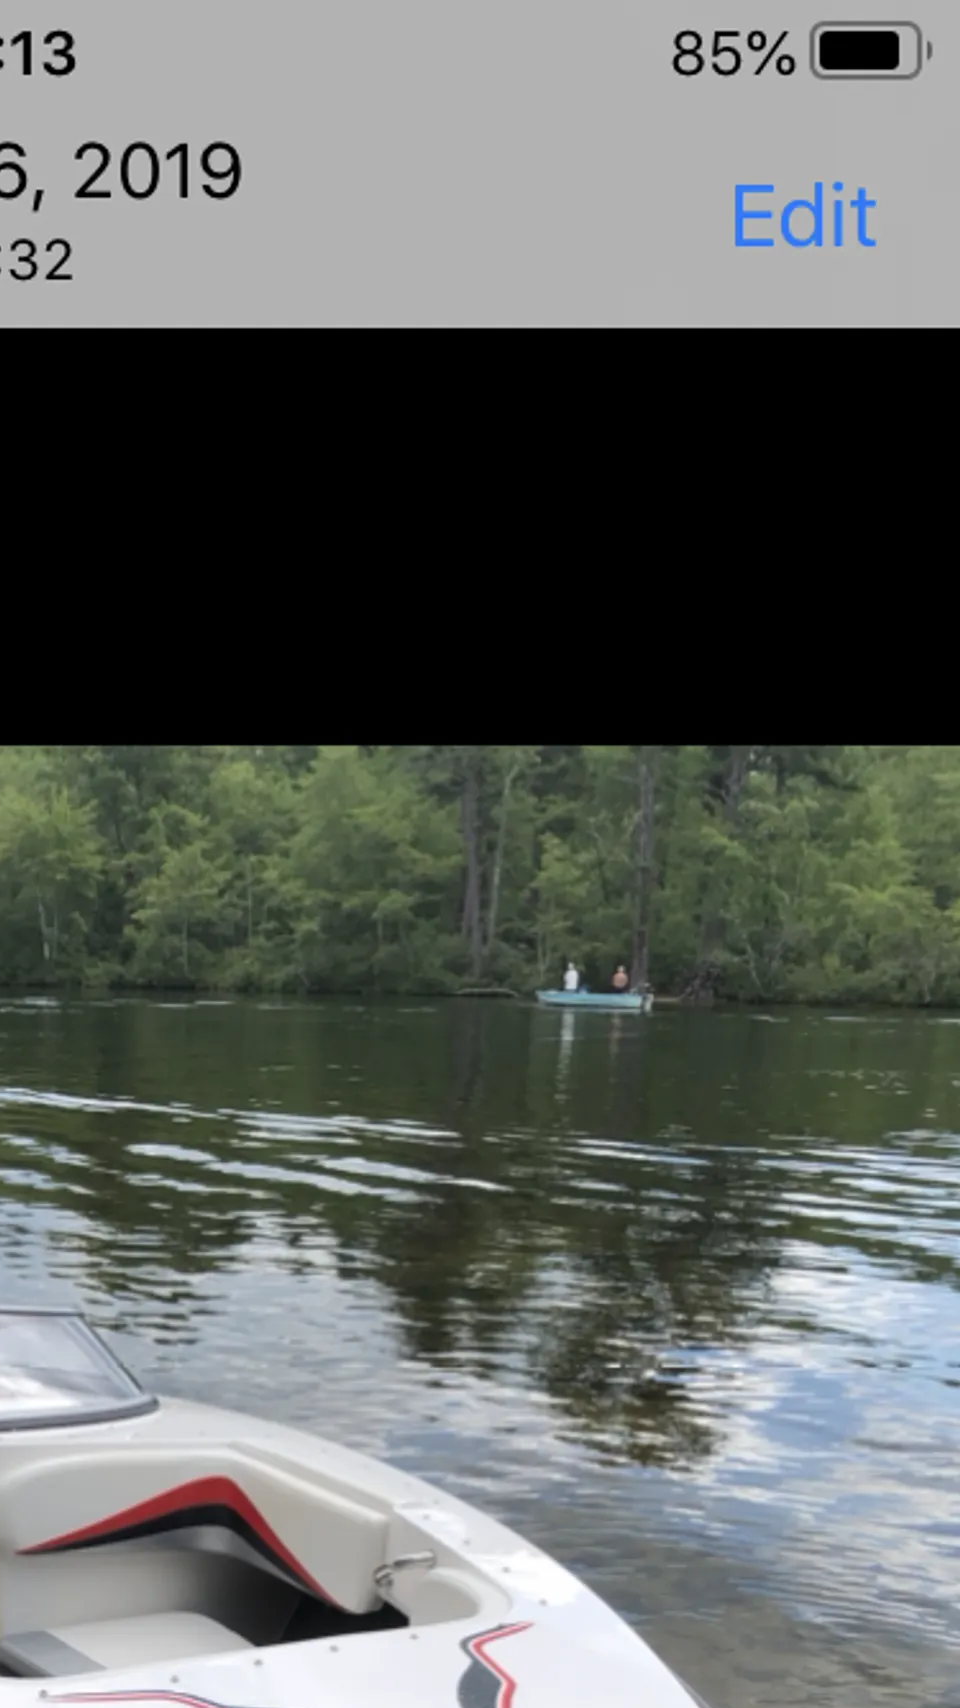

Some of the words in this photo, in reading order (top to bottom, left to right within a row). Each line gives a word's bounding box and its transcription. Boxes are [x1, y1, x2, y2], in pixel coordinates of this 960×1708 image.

[672, 29, 796, 77] 85%
[74, 140, 242, 201] 2019
[734, 181, 877, 248] Edit
